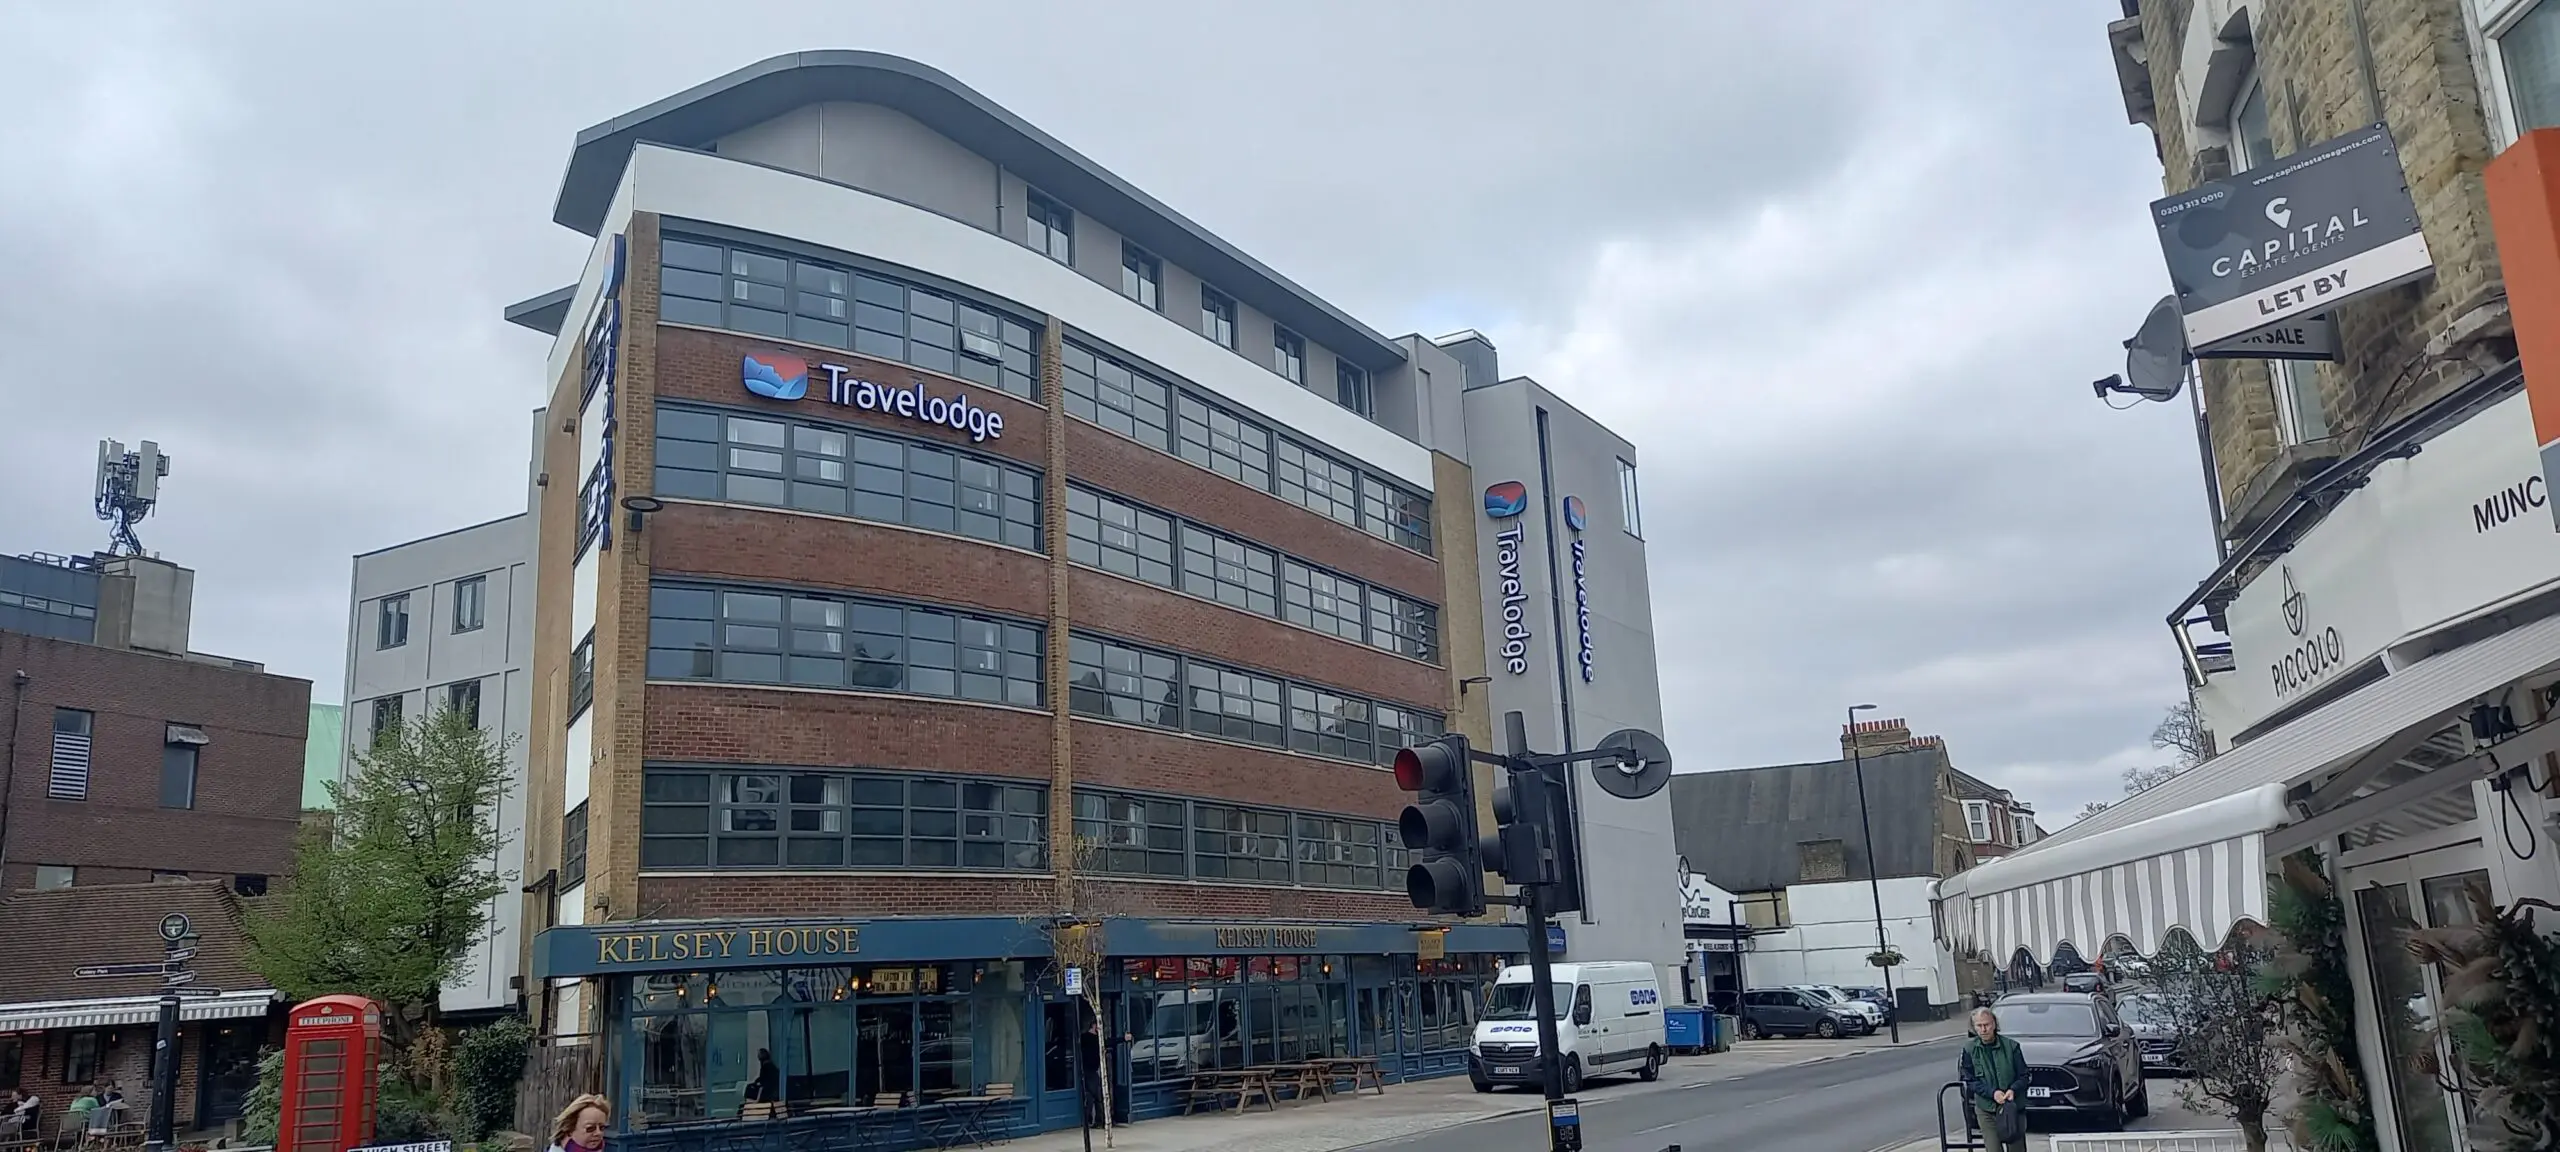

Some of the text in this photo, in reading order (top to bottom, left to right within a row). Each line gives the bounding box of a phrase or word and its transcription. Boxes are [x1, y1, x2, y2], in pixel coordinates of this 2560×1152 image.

[2252, 133, 2382, 186] www.capitalestateagents.com
[2160, 191, 2224, 216] 0208 313 0010
[2211, 207, 2369, 277] CAPITAL
[2241, 233, 2345, 278] ESTATE AGENTS
[2258, 269, 2348, 315] LET BY
[2266, 328, 2306, 345] SALE
[821, 363, 1004, 443] Travelodge
[1496, 521, 1531, 675] Travelodge
[1571, 539, 1595, 685] Travelodge
[2271, 626, 2341, 698] PICCOLO
[597, 927, 860, 965] KELSEY HOUSE
[1214, 928, 1318, 948] KELSEY HOUSE
[301, 1015, 351, 1026] TELEPHONE
[401, 1142, 448, 1152] STREET
